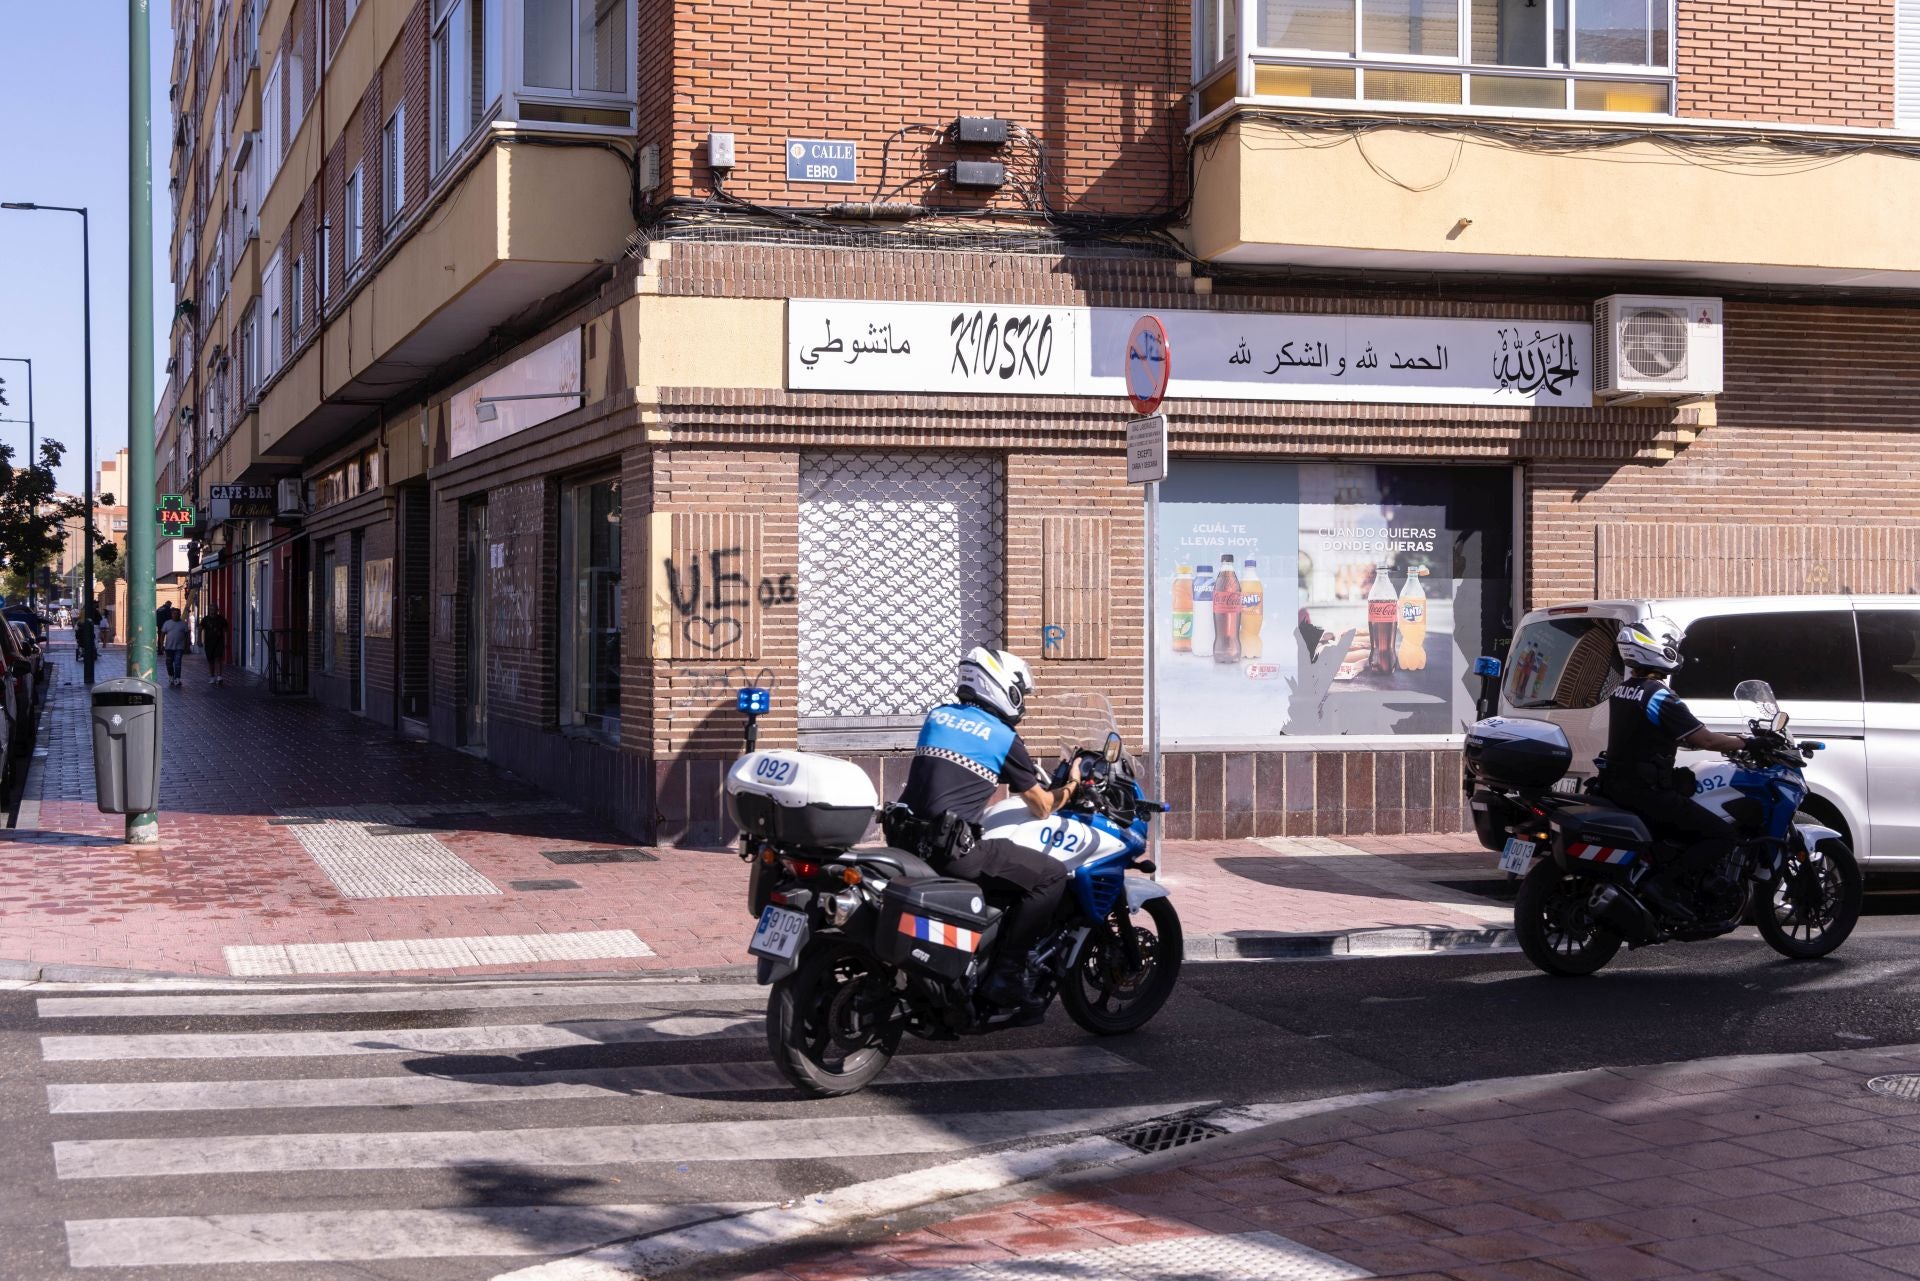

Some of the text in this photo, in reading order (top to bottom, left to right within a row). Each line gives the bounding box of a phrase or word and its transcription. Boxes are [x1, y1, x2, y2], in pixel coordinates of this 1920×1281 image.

[811, 144, 853, 159] CALLE
[806, 164, 838, 179] EBRO
[950, 310, 1053, 380] KIOSKO
[1229, 336, 1251, 366] لله
[1355, 340, 1379, 370] لله
[1389, 345, 1448, 371] الحمد
[161, 510, 191, 522] FAR
[1192, 521, 1247, 535] ¿CUÁL TE
[1319, 527, 1437, 539] CUANDO QUIERAS
[1180, 536, 1258, 546] LLEVAS HOY?
[1323, 541, 1434, 552] DONDE QUIERAS
[930, 710, 992, 741] POLICÍA
[757, 757, 790, 781] 092
[1040, 826, 1078, 853] 092
[1511, 841, 1533, 858] 0013
[1505, 856, 1523, 872] LWH
[762, 930, 789, 952] JPW
